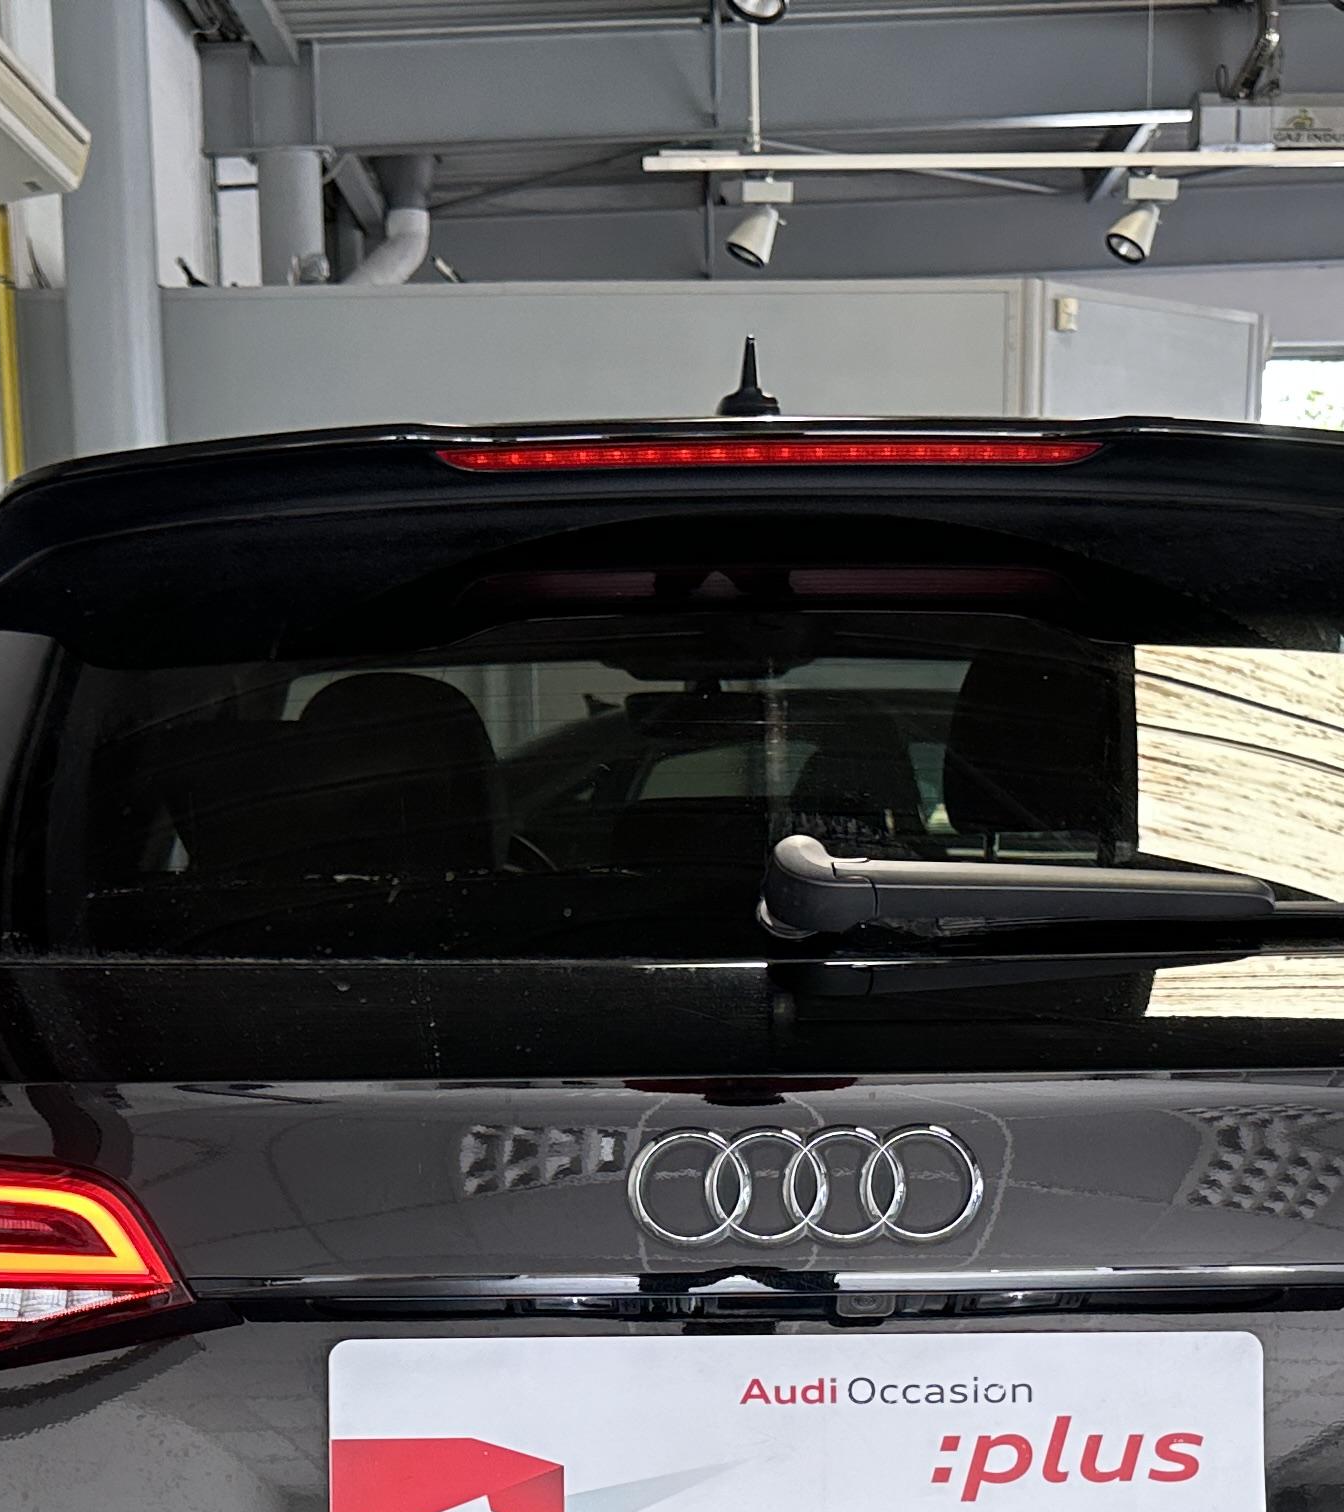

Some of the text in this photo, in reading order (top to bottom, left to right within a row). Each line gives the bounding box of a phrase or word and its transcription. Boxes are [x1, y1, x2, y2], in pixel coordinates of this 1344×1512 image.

[740, 1376, 1033, 1405] Audi Occasion
[931, 1416, 1204, 1502] :plus
